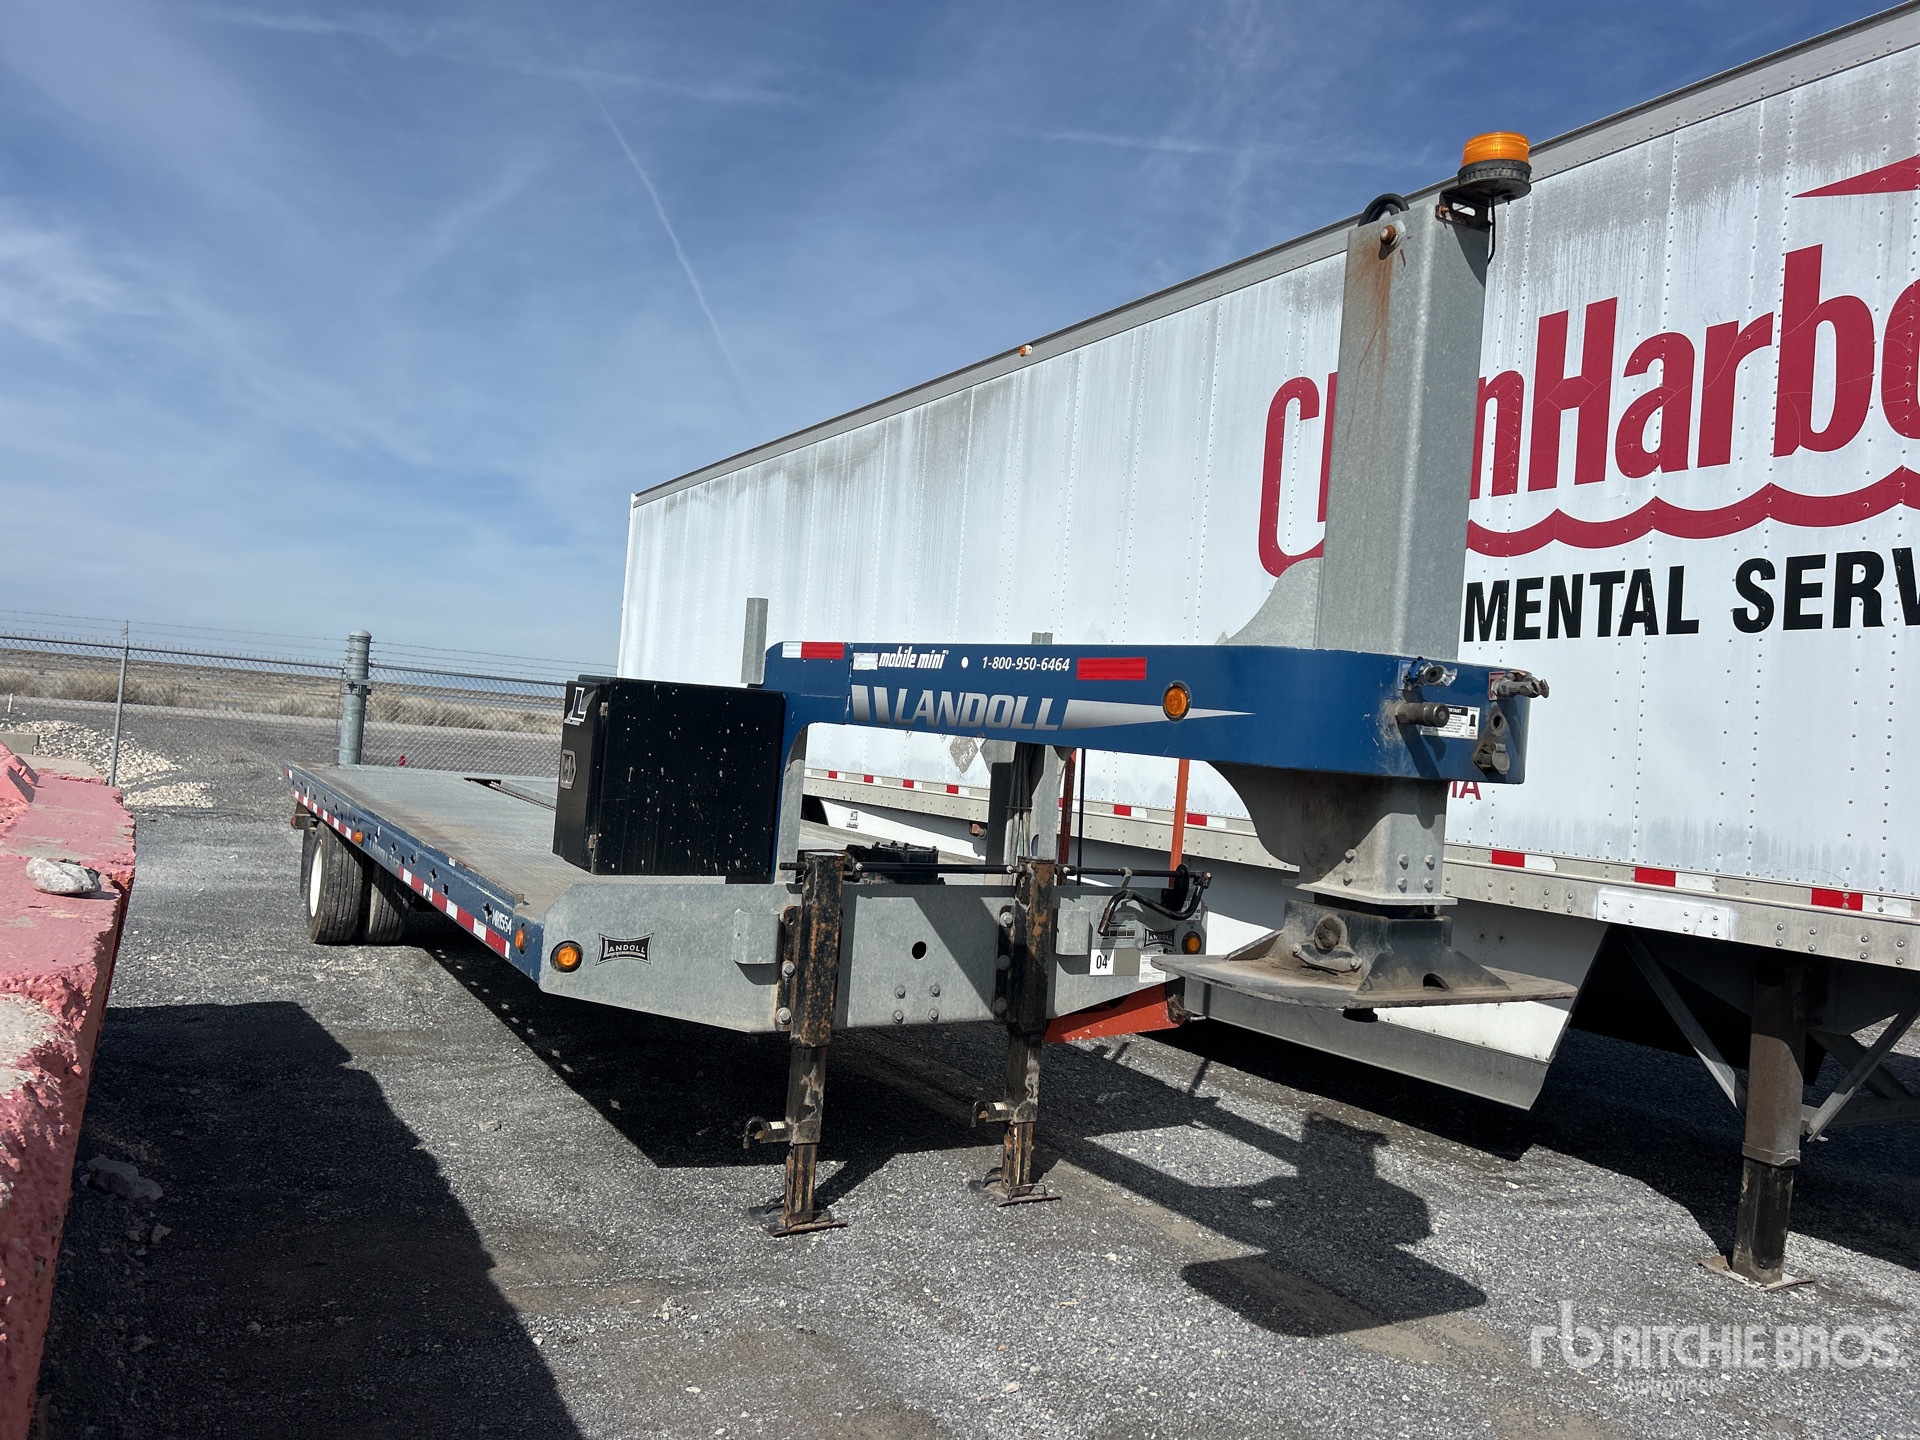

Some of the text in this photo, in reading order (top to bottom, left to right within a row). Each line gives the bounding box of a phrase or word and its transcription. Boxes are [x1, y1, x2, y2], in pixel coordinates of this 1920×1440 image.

[878, 646, 917, 669] mobile
[982, 656, 1071, 672] 1-800-950-6464
[893, 688, 1059, 731] LANDOLL
[603, 940, 646, 958] LANDOLL
[1096, 954, 1108, 969] 04
